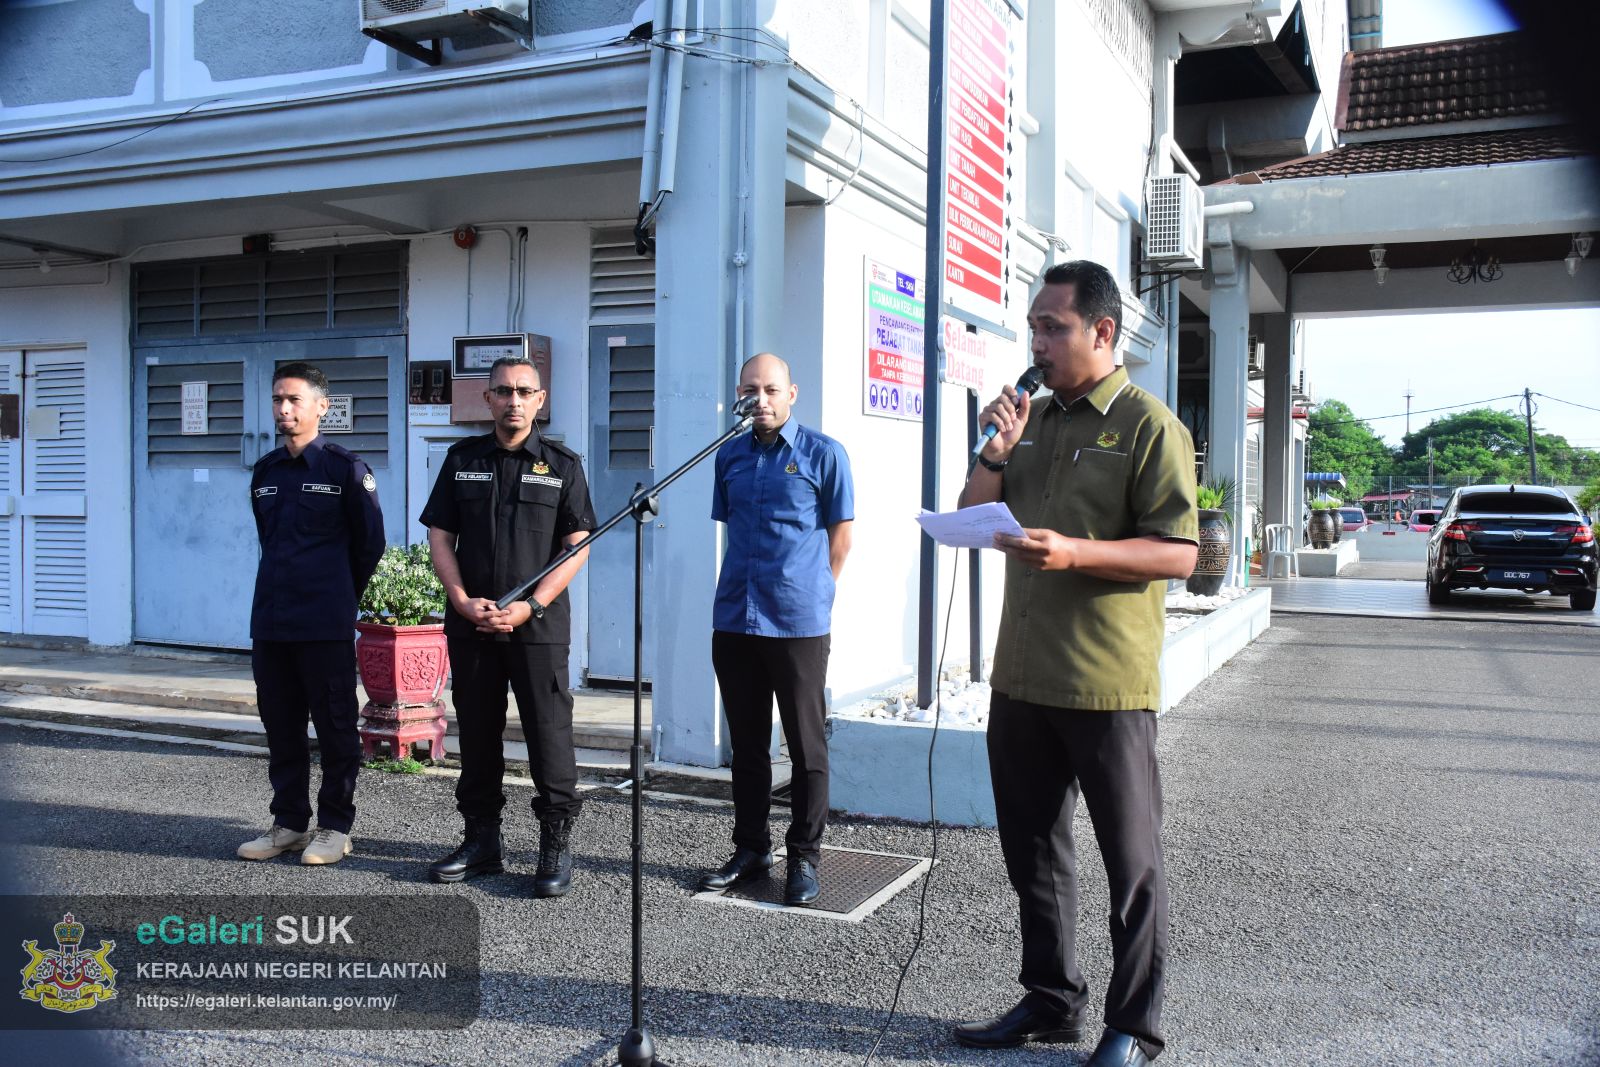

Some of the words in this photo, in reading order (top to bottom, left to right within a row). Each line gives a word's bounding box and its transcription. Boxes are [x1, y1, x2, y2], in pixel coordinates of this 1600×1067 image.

[961, 156, 975, 178] TANAH
[949, 177, 959, 196] UNIT
[948, 234, 962, 255] SURAU
[947, 263, 964, 284] KANTIN
[872, 289, 899, 312] UTAMAKAN
[876, 327, 904, 350] PEJABAT
[945, 321, 986, 358] Selamat
[876, 353, 906, 370] DILARANG
[881, 367, 895, 379] TANPA
[946, 355, 984, 391] Datang
